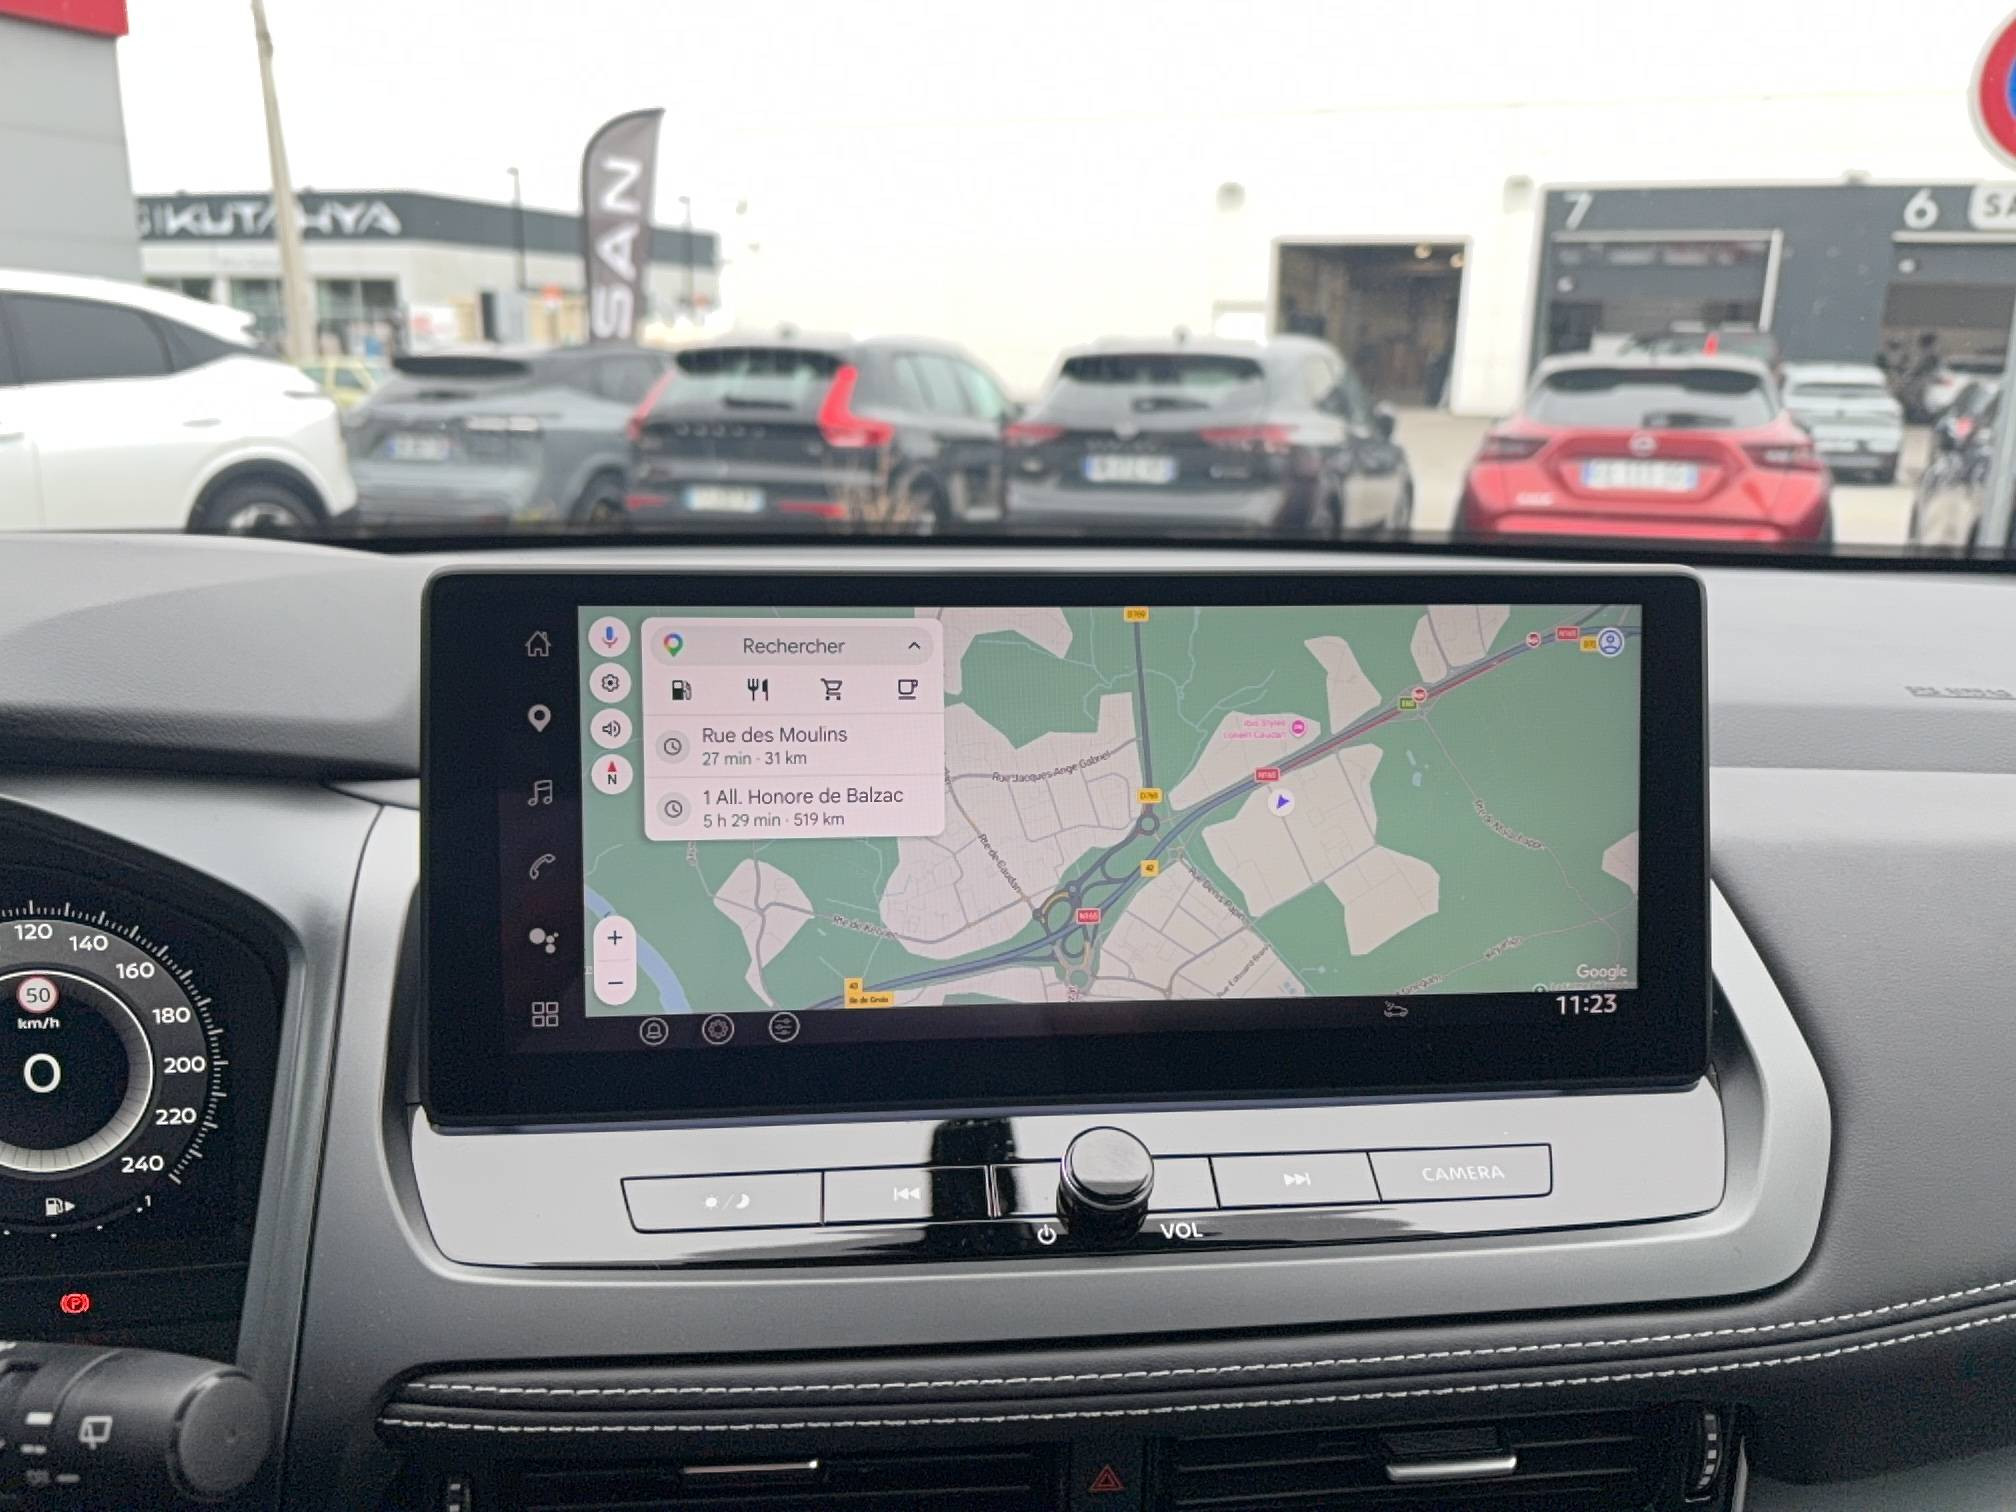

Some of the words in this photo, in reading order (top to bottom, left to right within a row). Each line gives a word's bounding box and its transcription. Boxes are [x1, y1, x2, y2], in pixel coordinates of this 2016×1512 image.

[1563, 190, 1593, 231] 7
[1903, 188, 1939, 230] 6
[743, 637, 845, 656] Rechercher
[702, 727, 736, 744] Rue
[741, 727, 774, 744] des
[779, 726, 848, 744] Moulins
[702, 752, 720, 767] 27
[724, 752, 751, 766] min
[765, 752, 781, 765] 31
[785, 751, 807, 765] km
[608, 774, 617, 785] N
[703, 791, 710, 805] 1
[716, 788, 743, 805] All.
[748, 789, 813, 805] Honore
[818, 788, 841, 804] de
[847, 787, 904, 804] Balzac
[703, 815, 713, 829] 5
[717, 813, 727, 828] h
[731, 814, 749, 828] 29
[754, 812, 781, 827] min
[793, 812, 819, 826] 519
[823, 812, 845, 826] km
[14, 923, 53, 941] 120
[68, 935, 109, 952] 140
[115, 961, 155, 979] 160
[1576, 963, 1629, 981] Google
[26, 987, 51, 1003] 50
[1555, 992, 1618, 1015] 11:23
[17, 1017, 60, 1030] km/h
[152, 1007, 191, 1025] 180
[163, 1056, 206, 1074] 200
[155, 1107, 197, 1126] 220
[121, 1155, 164, 1174] 240
[1421, 1164, 1505, 1184] CAMERA
[145, 1195, 151, 1207] 1
[1160, 1221, 1204, 1241] VOL
